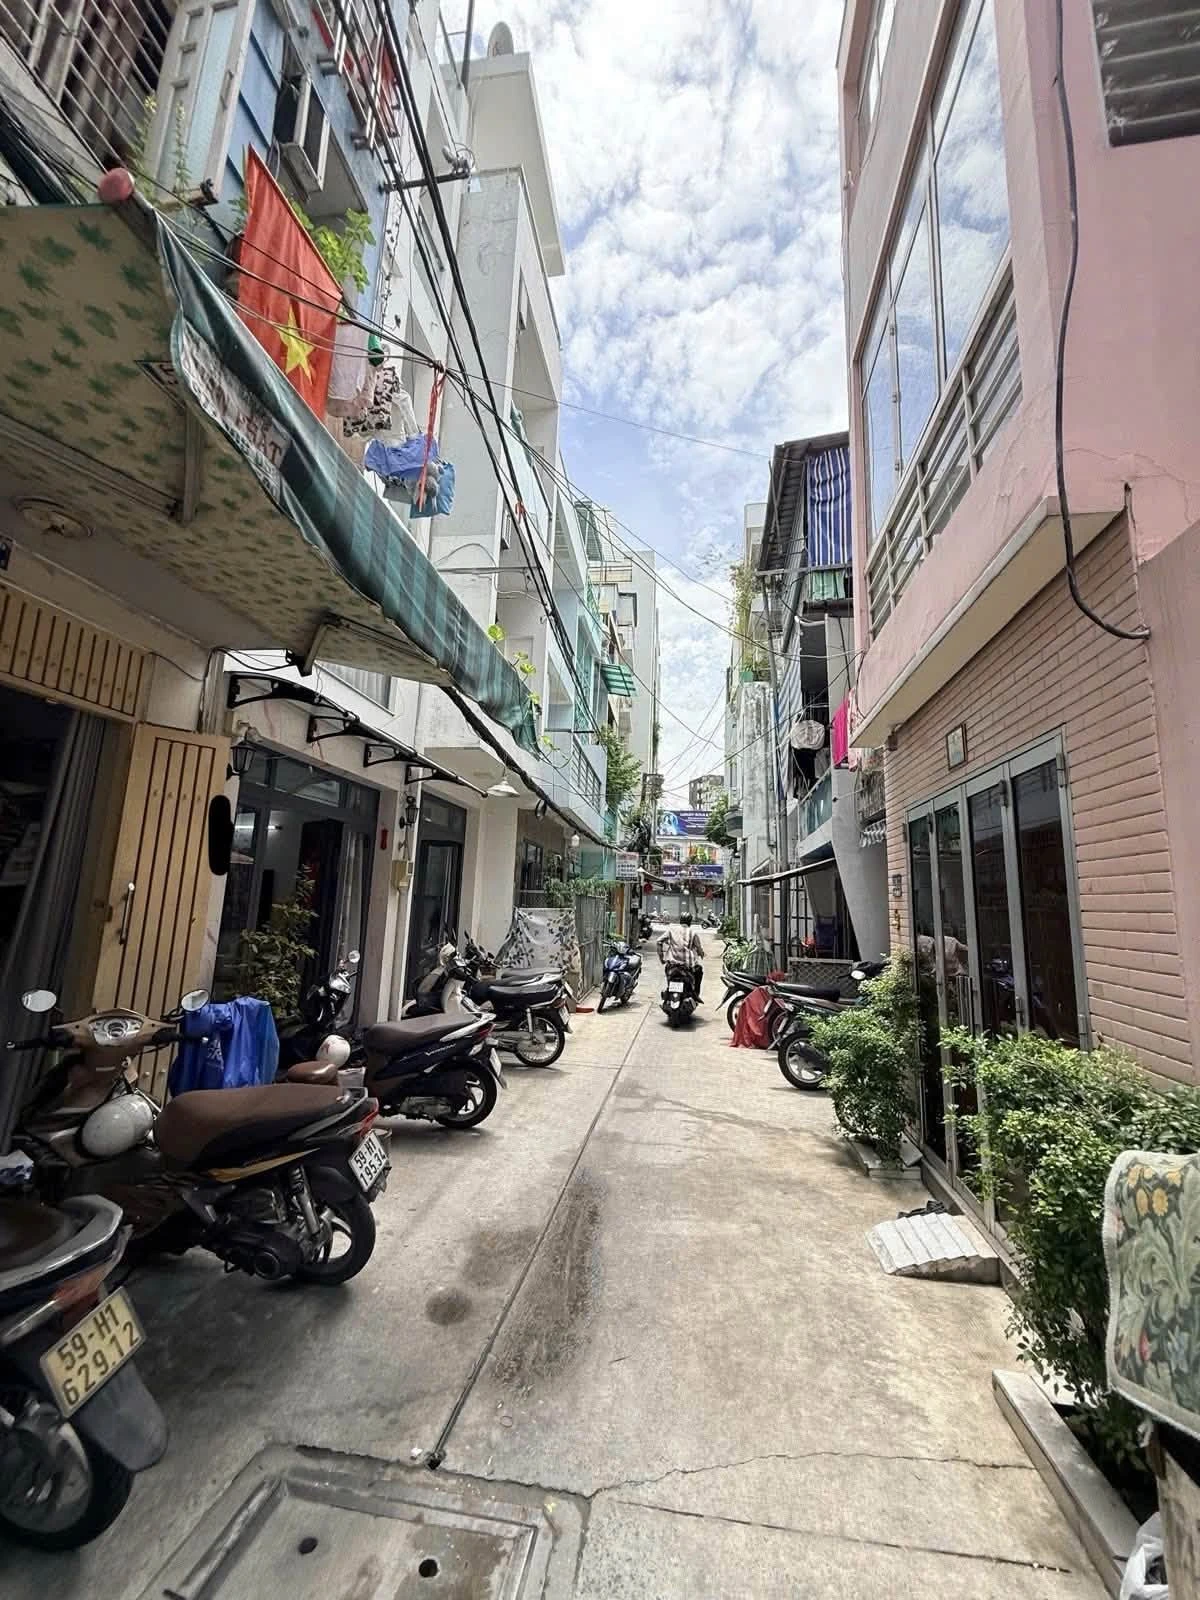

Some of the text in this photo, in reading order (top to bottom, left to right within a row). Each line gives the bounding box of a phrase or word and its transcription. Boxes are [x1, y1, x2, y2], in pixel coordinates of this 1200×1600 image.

[354, 1138, 376, 1169] 59-H1
[360, 1148, 386, 1186] 195.34
[58, 1304, 119, 1371] 59-H1
[62, 1321, 139, 1405] 629.12
